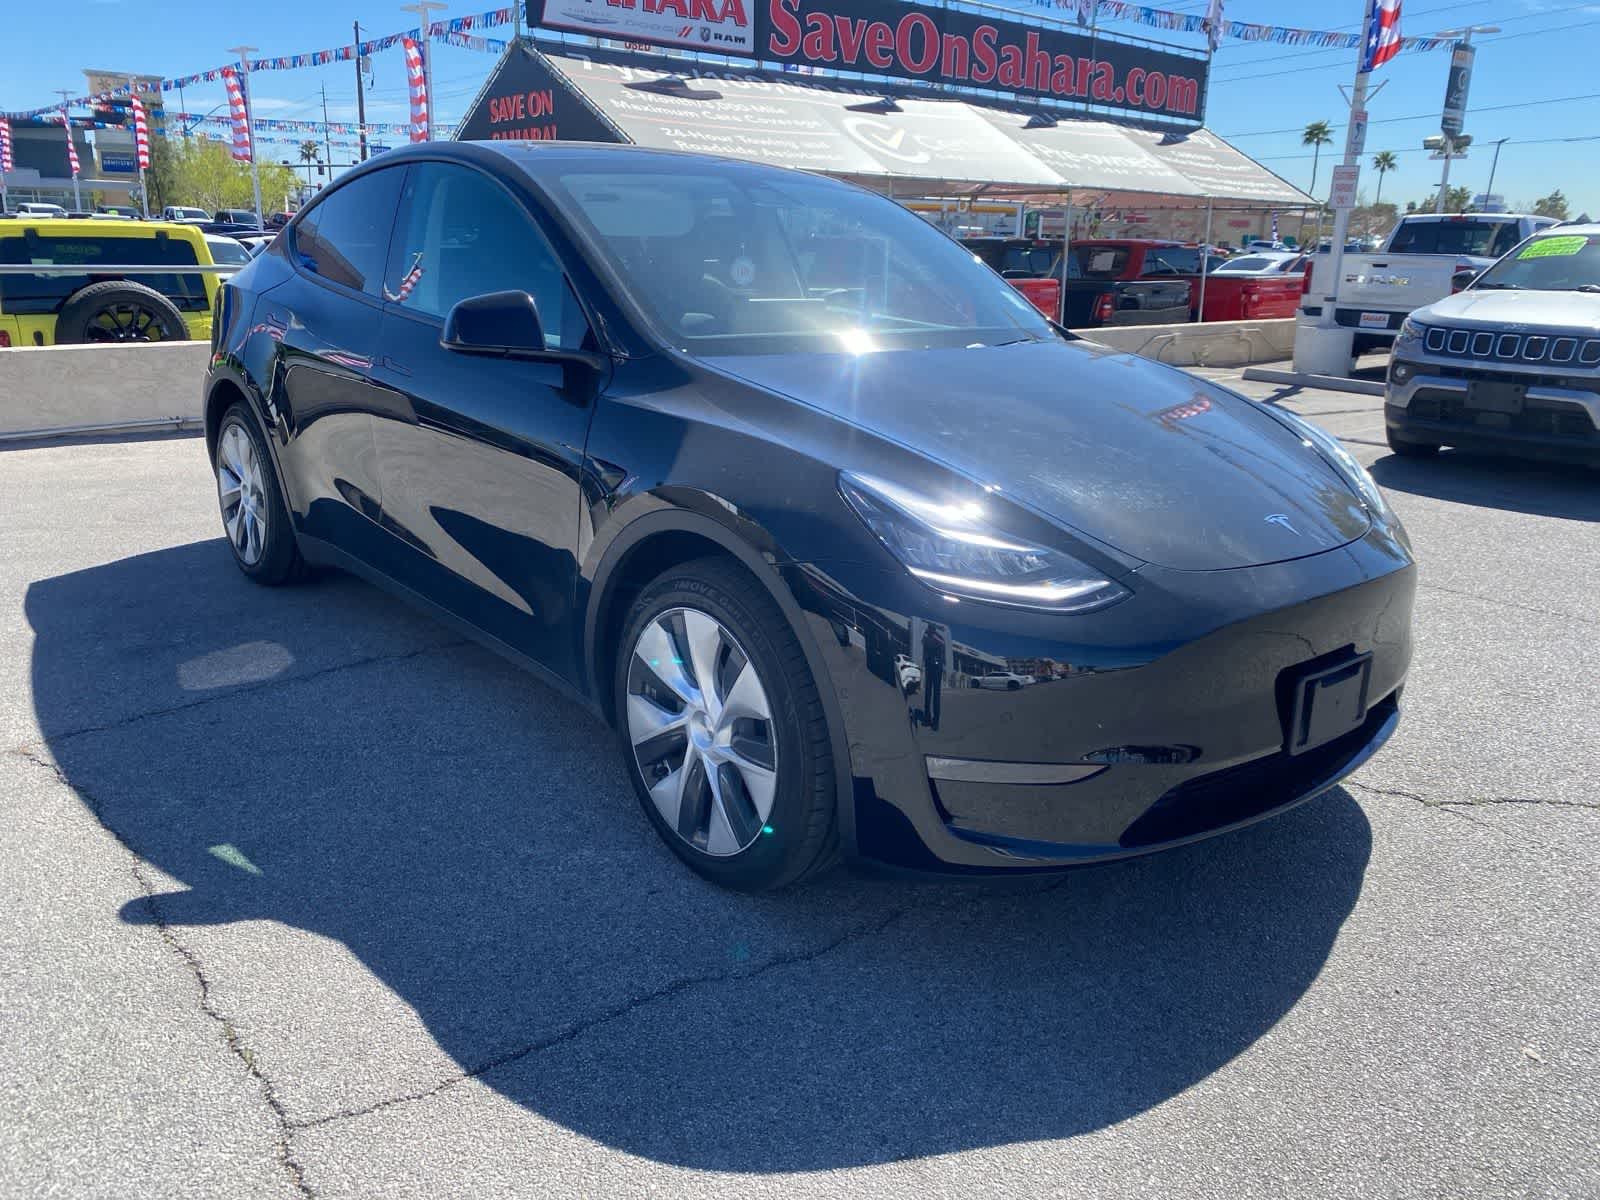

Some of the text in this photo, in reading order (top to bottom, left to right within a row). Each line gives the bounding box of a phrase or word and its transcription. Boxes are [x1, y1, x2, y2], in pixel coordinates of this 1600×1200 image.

[713, 34, 746, 44] RAM
[768, 0, 1199, 115] SaveOnSahara.com
[489, 90, 553, 123] SAVE ON
